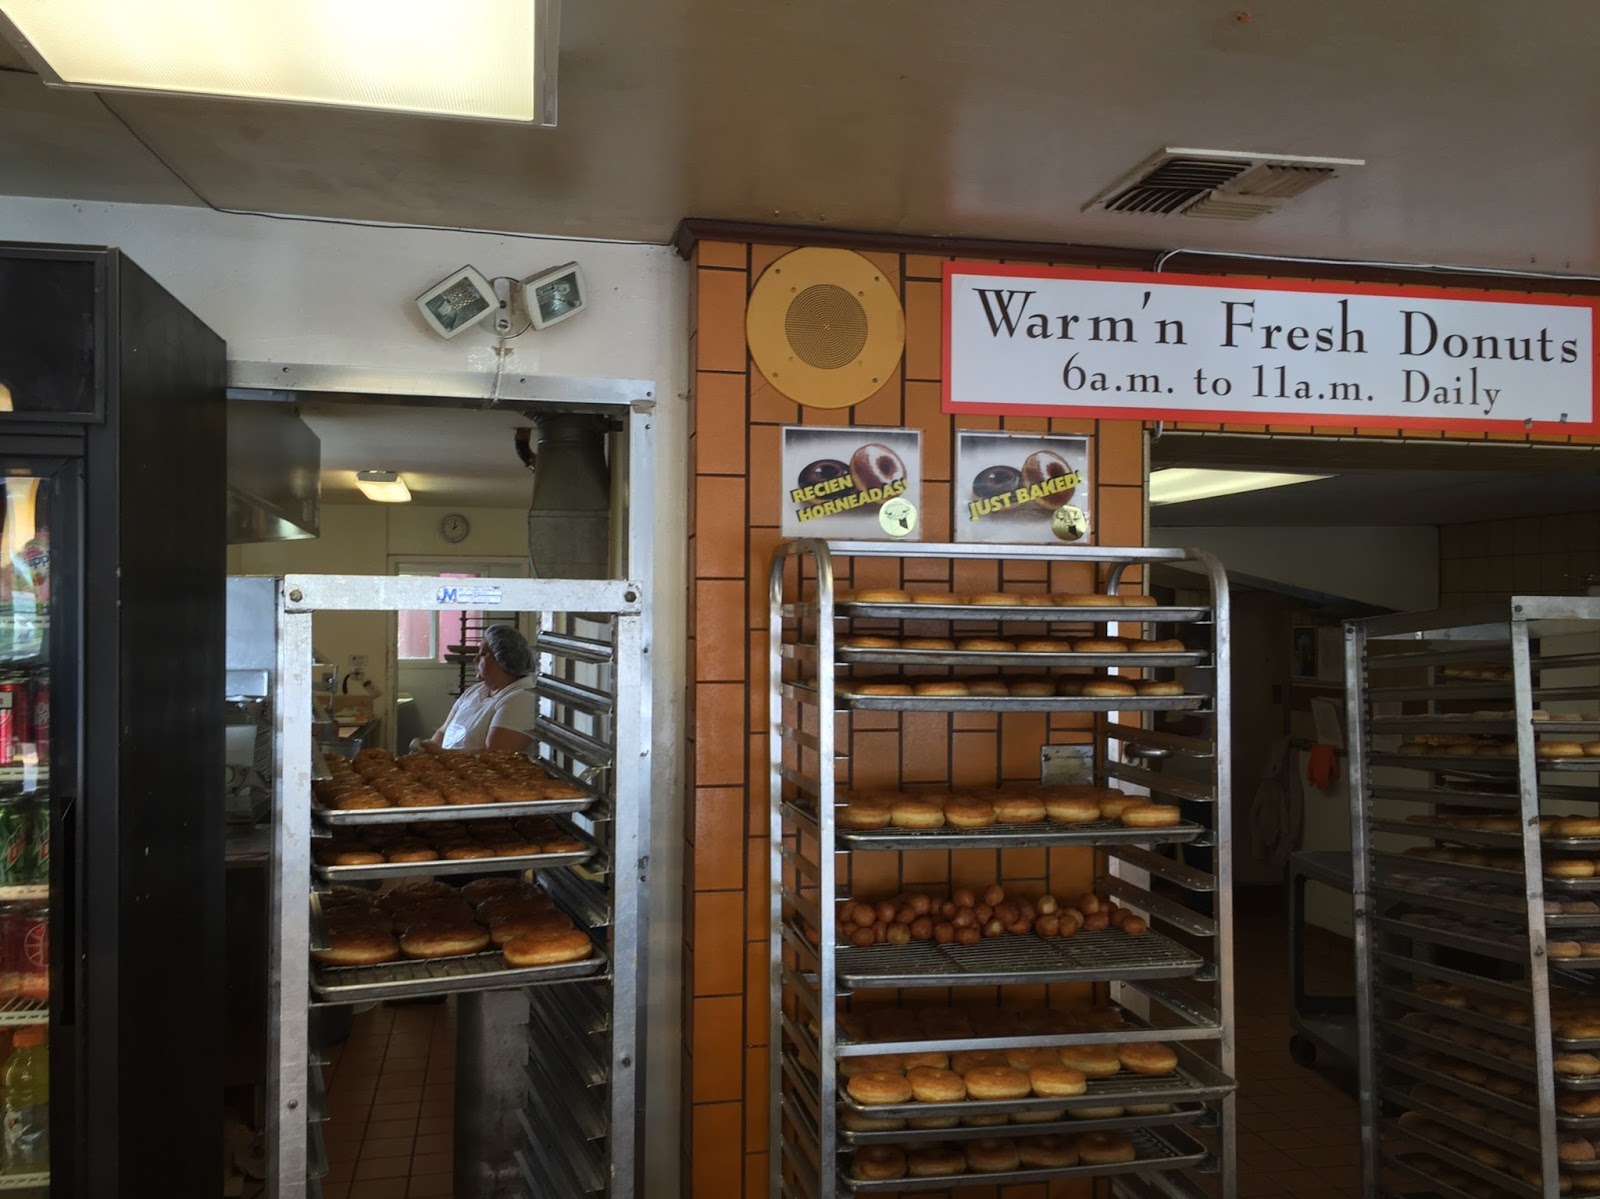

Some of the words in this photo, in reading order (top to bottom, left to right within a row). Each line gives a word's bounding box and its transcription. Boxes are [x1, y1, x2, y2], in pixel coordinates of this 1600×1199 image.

[1220, 298, 1368, 354] Fresh
[1399, 309, 1578, 364] Donuts
[1062, 352, 1174, 394] 6a.m.
[1193, 367, 1232, 396] to
[1252, 363, 1374, 402] 11a.m.
[1400, 366, 1501, 415] Daily
[790, 474, 854, 503] RECIEN
[796, 478, 908, 523] HORNEADAS!
[968, 491, 1013, 521] JUST
[1015, 470, 1083, 505] BAKED!
